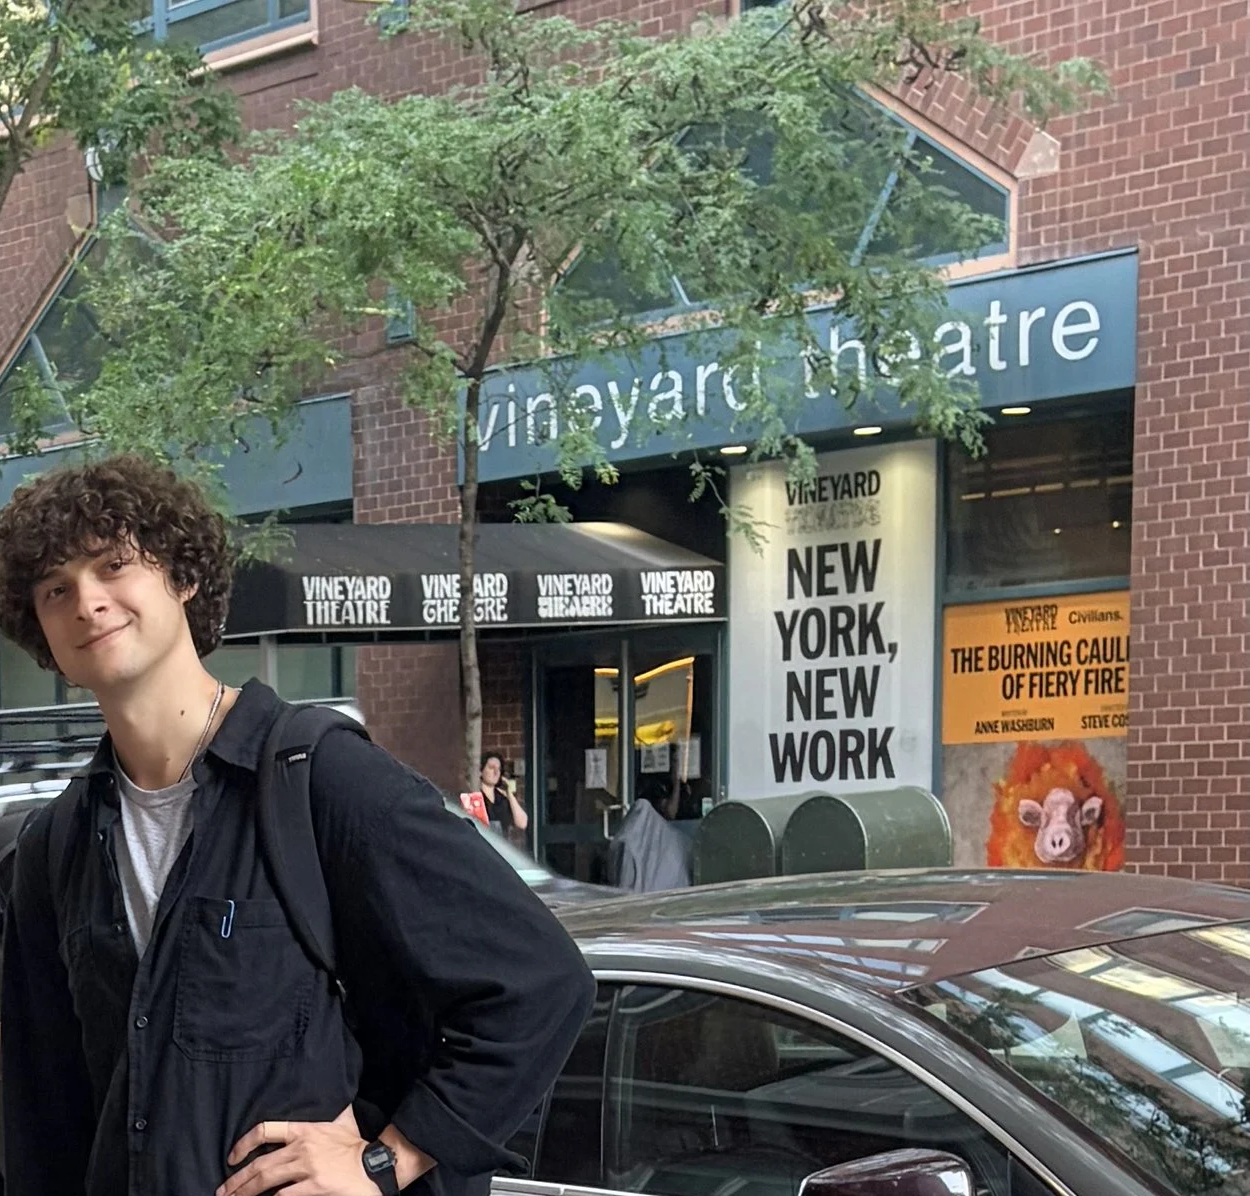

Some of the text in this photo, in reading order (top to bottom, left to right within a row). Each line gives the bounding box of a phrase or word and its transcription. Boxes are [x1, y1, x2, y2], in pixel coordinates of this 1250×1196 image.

[785, 469, 881, 506] VINEYARD
[640, 570, 715, 594] VINEYARD
[787, 538, 882, 600] NEW
[302, 576, 391, 600] VINEYARD
[421, 573, 508, 599] VINEARD
[537, 573, 613, 597] VINEYARD
[303, 600, 391, 625] THEATRE
[641, 593, 715, 616] THEATRE
[774, 601, 898, 663] YORK,
[951, 646, 984, 674] THE
[988, 640, 1072, 672] BURNING
[786, 665, 881, 722] NEW
[1002, 666, 1126, 700] OF FIERY FIRE
[974, 717, 1055, 735] ANNE WASHBURN
[1081, 714, 1109, 729] STEVE
[768, 726, 896, 783] WORK
